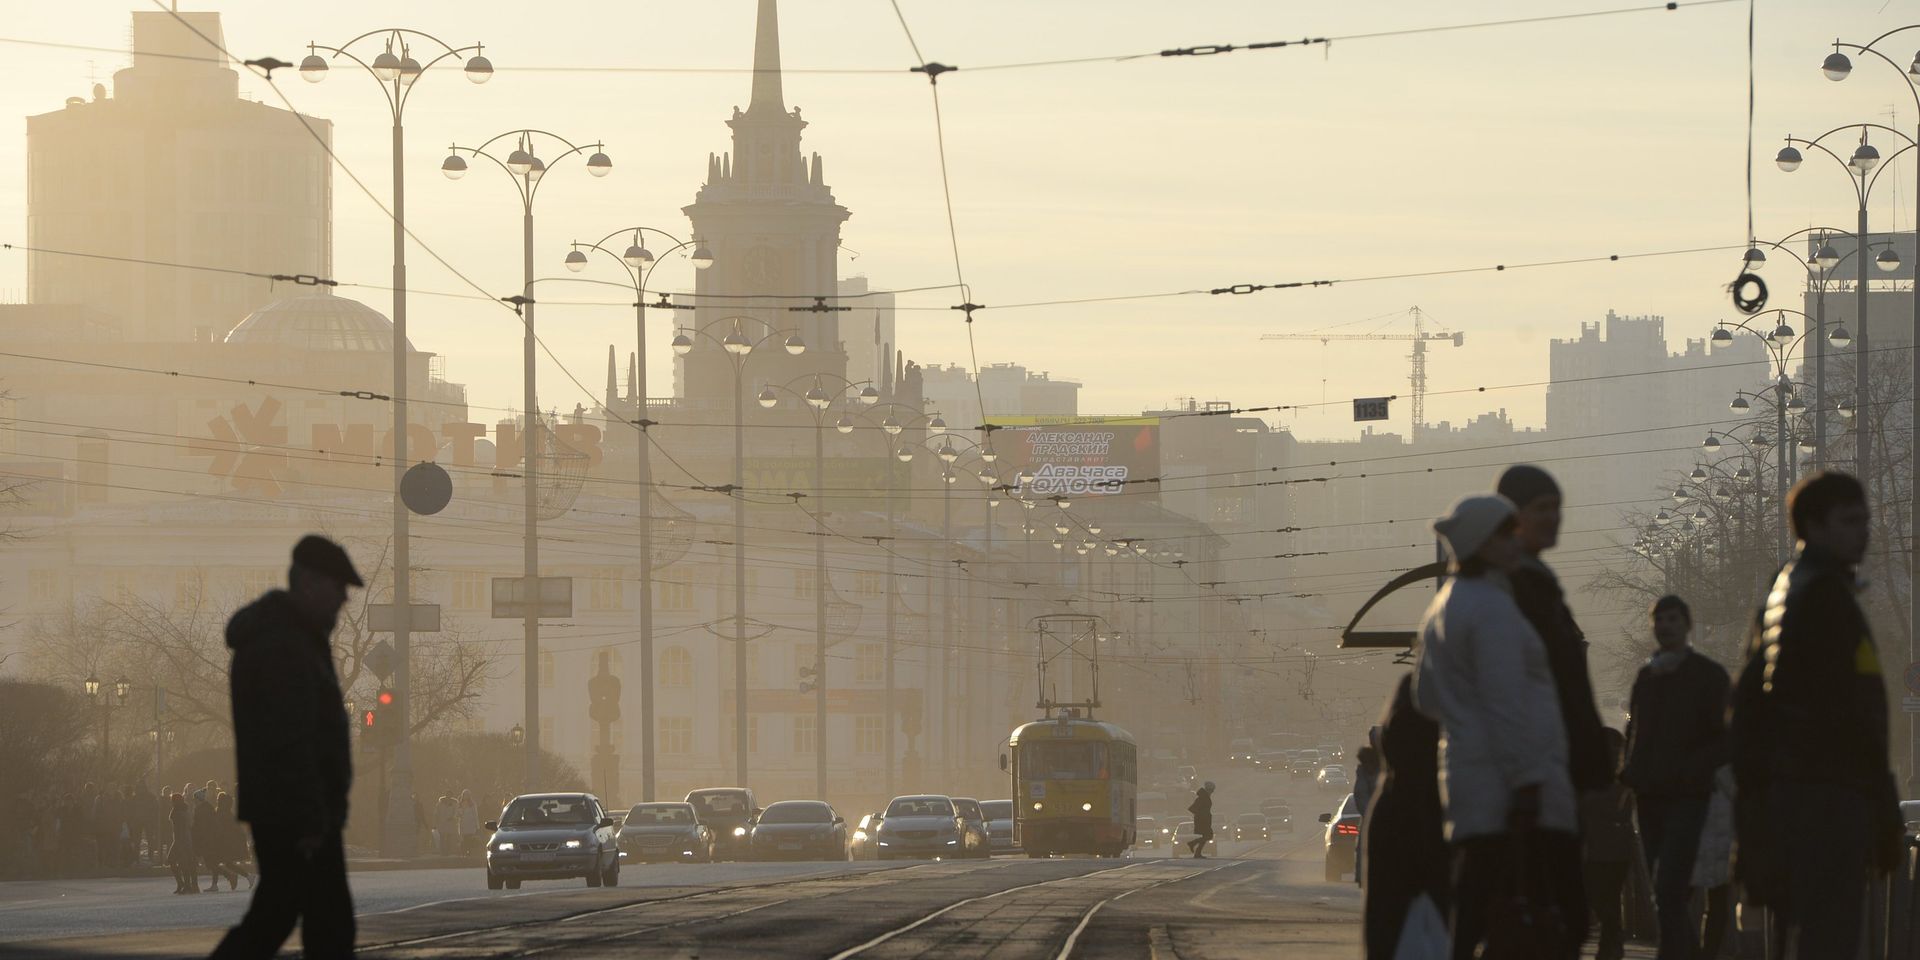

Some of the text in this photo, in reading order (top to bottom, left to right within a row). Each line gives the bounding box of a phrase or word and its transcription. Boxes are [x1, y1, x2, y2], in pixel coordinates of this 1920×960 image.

[1356, 402, 1387, 418] 1135
[1026, 432, 1115, 444] АЛЕКСАНДР
[312, 423, 603, 469] МОТИВ
[1032, 442, 1109, 456] ГРАДСКИЙ
[1035, 463, 1127, 478] Два часа
